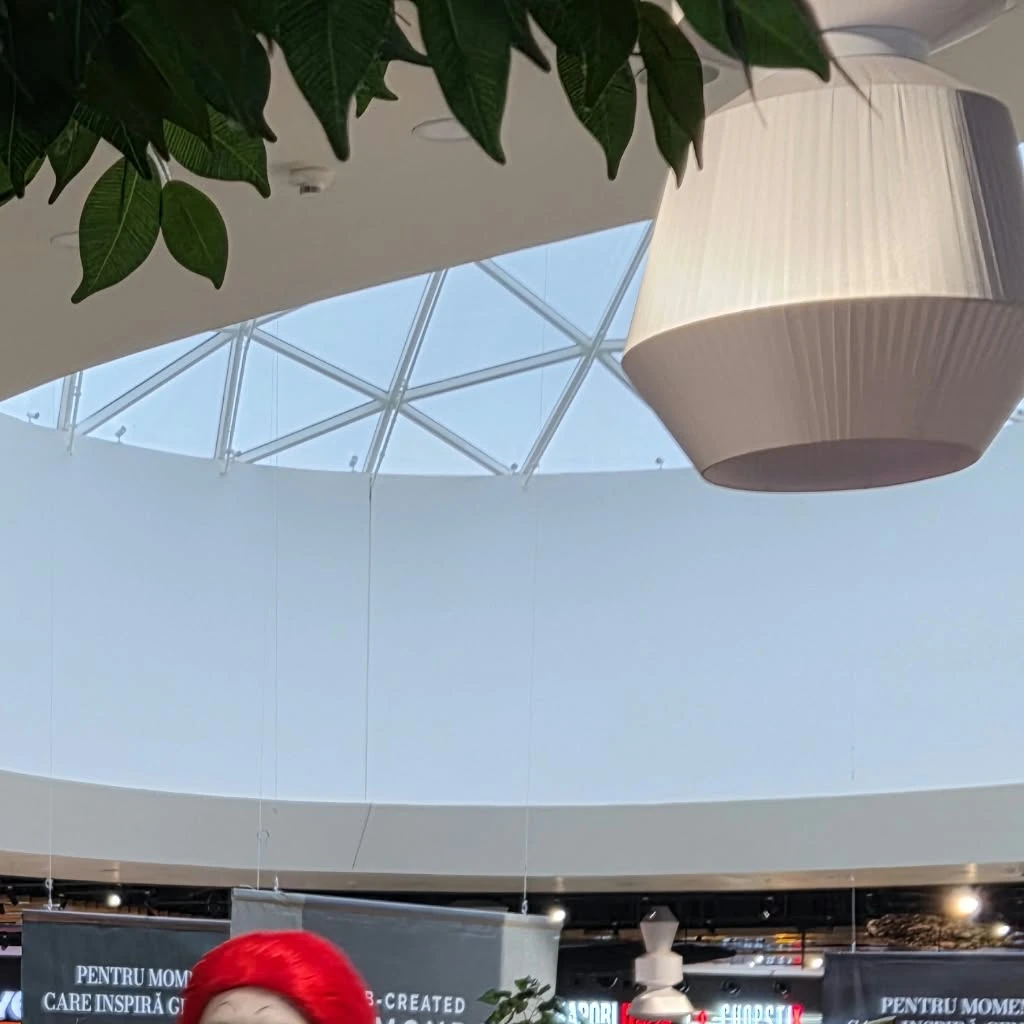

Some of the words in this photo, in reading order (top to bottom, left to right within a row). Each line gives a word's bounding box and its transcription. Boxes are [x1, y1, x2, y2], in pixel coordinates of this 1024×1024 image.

[76, 965, 145, 986] PENTRU
[148, 968, 192, 989] MOM
[42, 991, 92, 1012] CARE
[94, 991, 164, 1015] INSPIRĂ
[880, 997, 958, 1014] PENTRU
[961, 997, 1024, 1016] MOME
